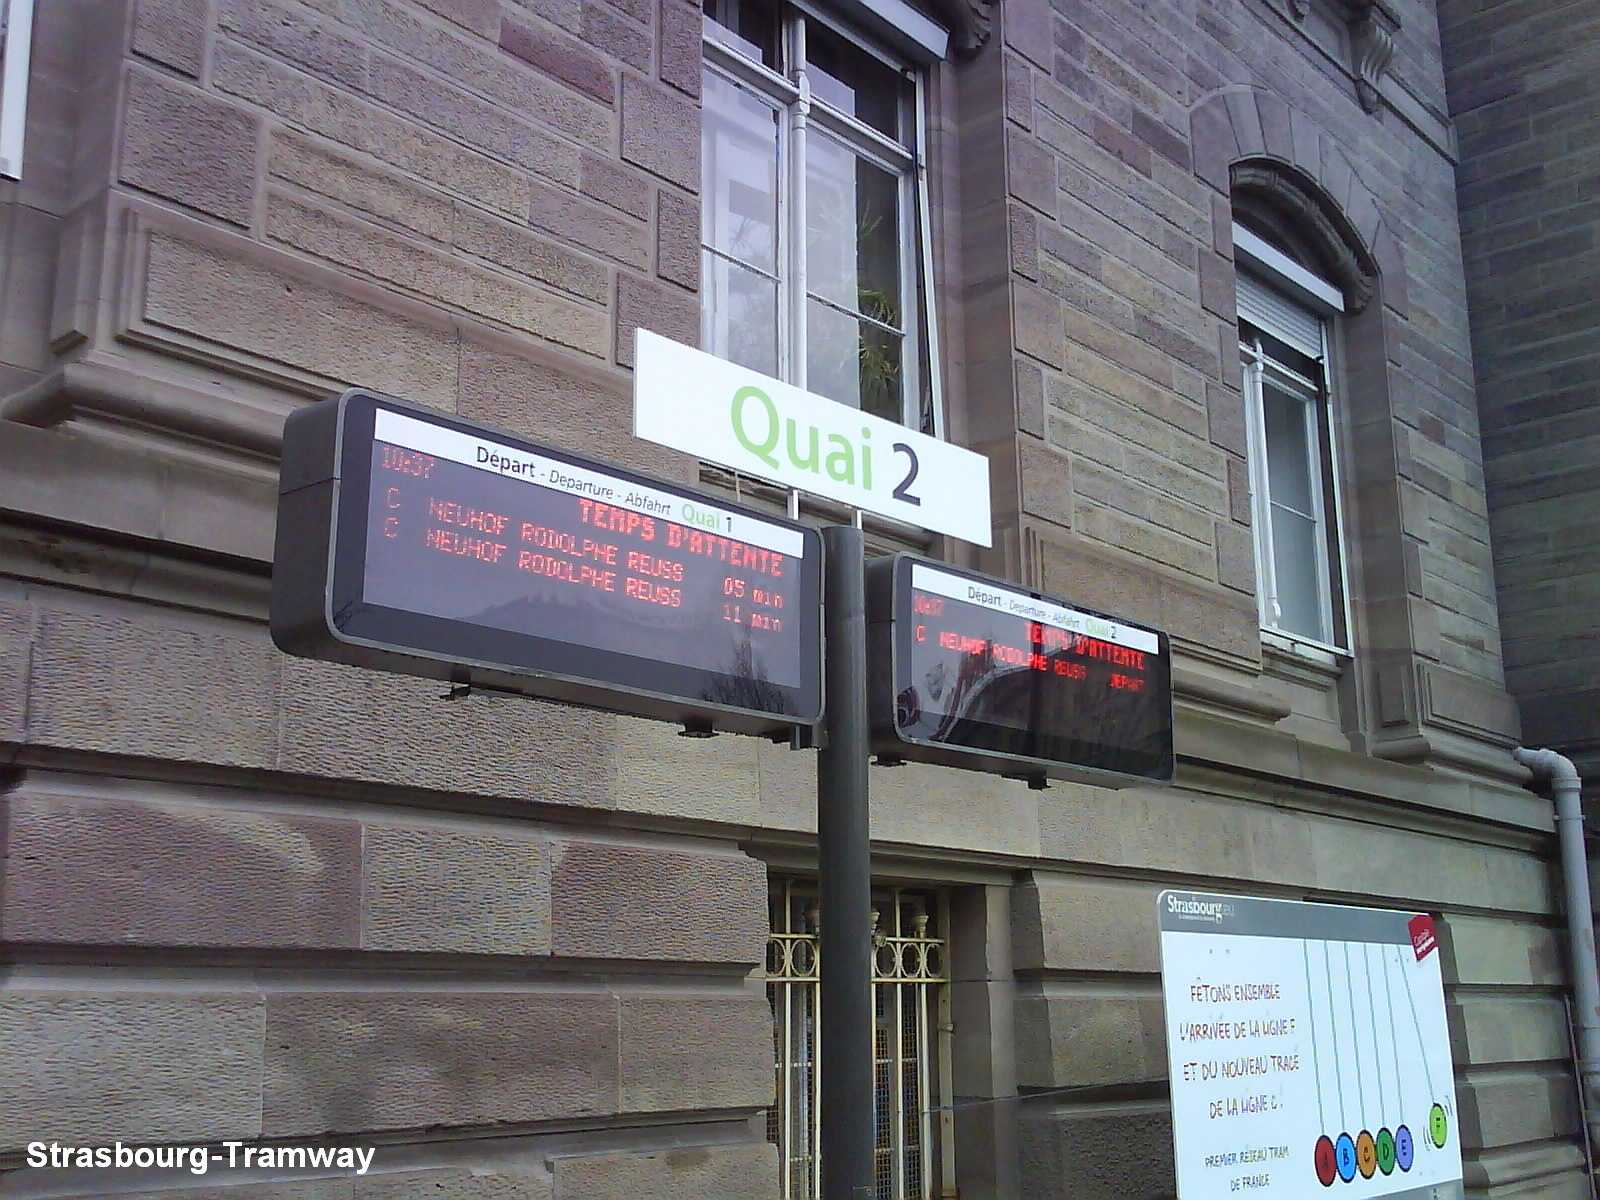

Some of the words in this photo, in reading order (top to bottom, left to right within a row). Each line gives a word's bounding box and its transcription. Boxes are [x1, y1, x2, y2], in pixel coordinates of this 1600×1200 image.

[731, 385, 873, 492] Quai
[892, 442, 921, 507] 2
[476, 446, 536, 478] Départ
[549, 469, 614, 500] Departure
[625, 492, 671, 516] Abfahrt
[682, 503, 720, 529] Quai
[387, 487, 400, 509] C
[429, 498, 509, 535] NEUHOF
[521, 522, 618, 566] RODOLPHE
[627, 551, 684, 582] REUSS
[753, 589, 784, 609] min
[578, 499, 656, 542] TEMPS
[666, 522, 785, 577] D'ATTENTE
[426, 529, 507, 563] NEUHOF
[518, 551, 616, 592] RODOLPHE
[624, 577, 681, 608] REUSS
[751, 612, 784, 632] min
[968, 586, 1001, 606] Départ
[916, 624, 926, 642] C
[1234, 984, 1280, 1001] ENSEMBLE
[1234, 1021, 1246, 1040] DE
[1249, 1019, 1260, 1037] LA
[1201, 1060, 1218, 1080] DU
[1221, 1055, 1268, 1078] NOUVEAU
[1209, 1100, 1223, 1119] DE
[1226, 1097, 1238, 1116] LA
